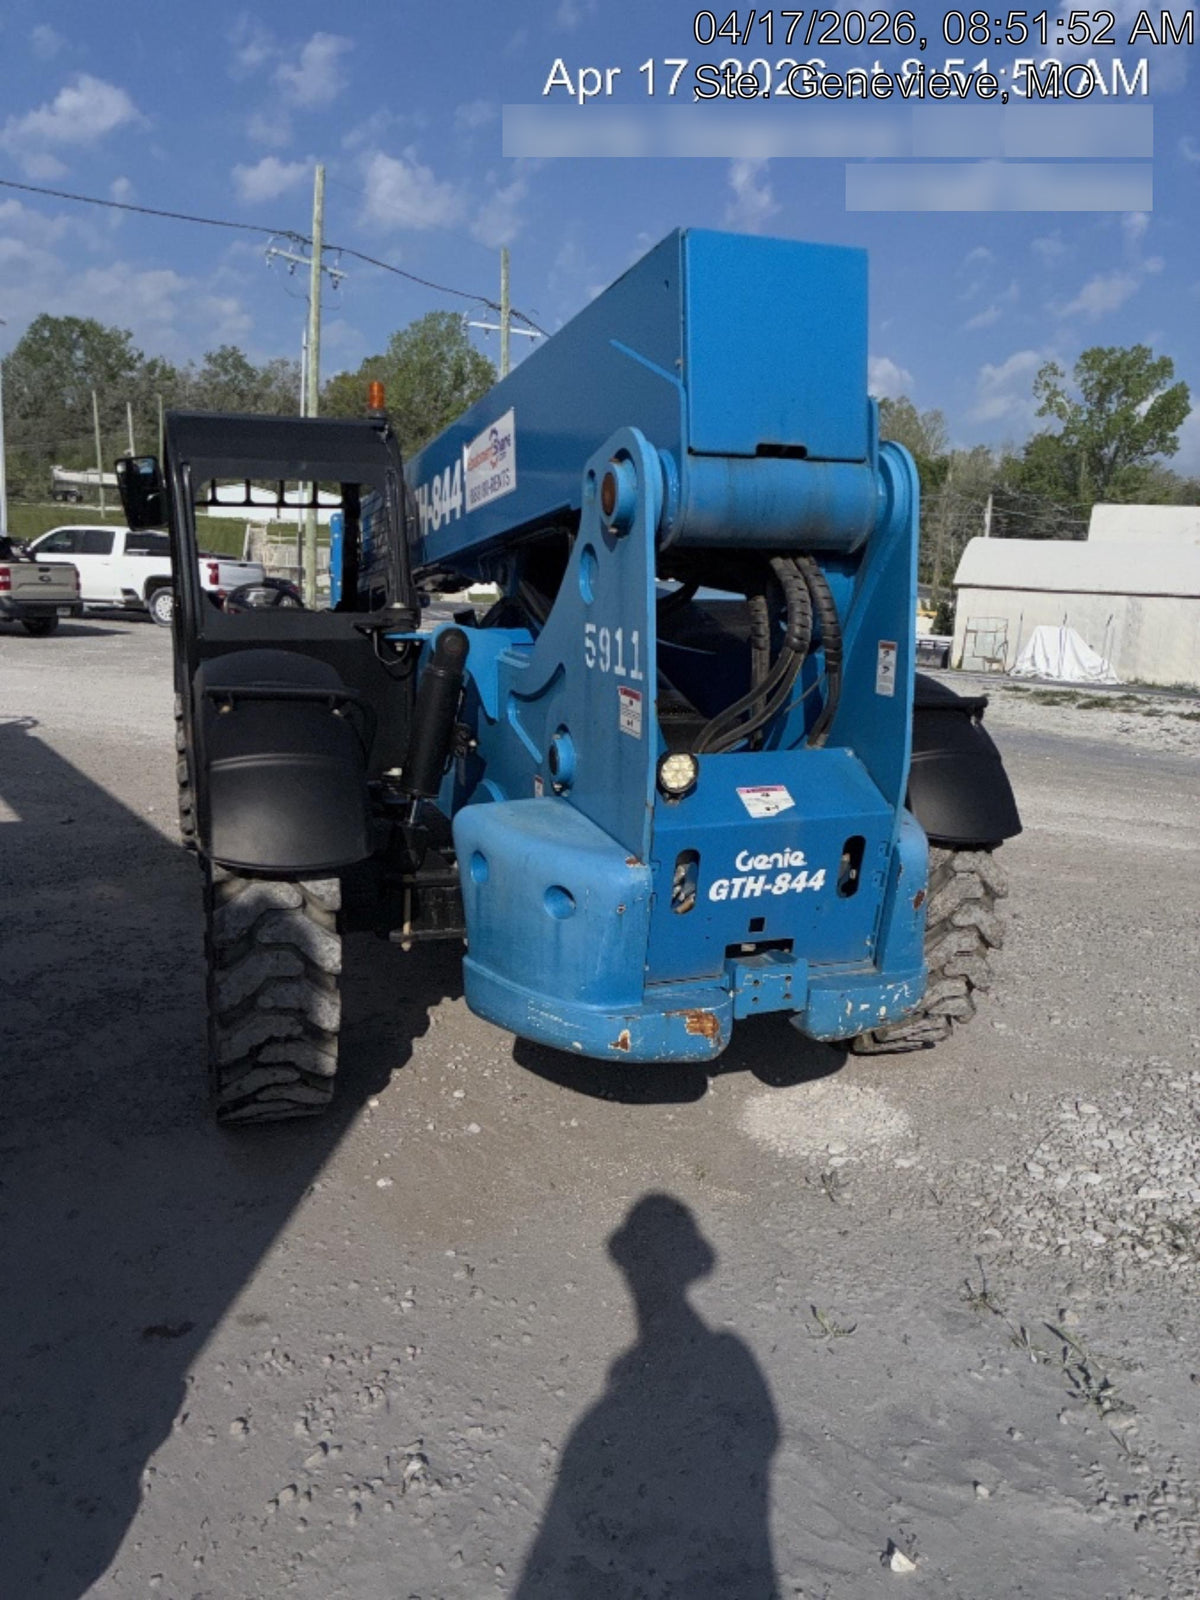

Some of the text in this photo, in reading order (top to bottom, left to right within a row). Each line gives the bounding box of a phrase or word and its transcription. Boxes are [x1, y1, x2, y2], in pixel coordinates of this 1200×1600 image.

[415, 459, 462, 535] H-844
[584, 623, 643, 681] 5911
[735, 848, 807, 872] Genie
[709, 869, 826, 901] GTH-844
